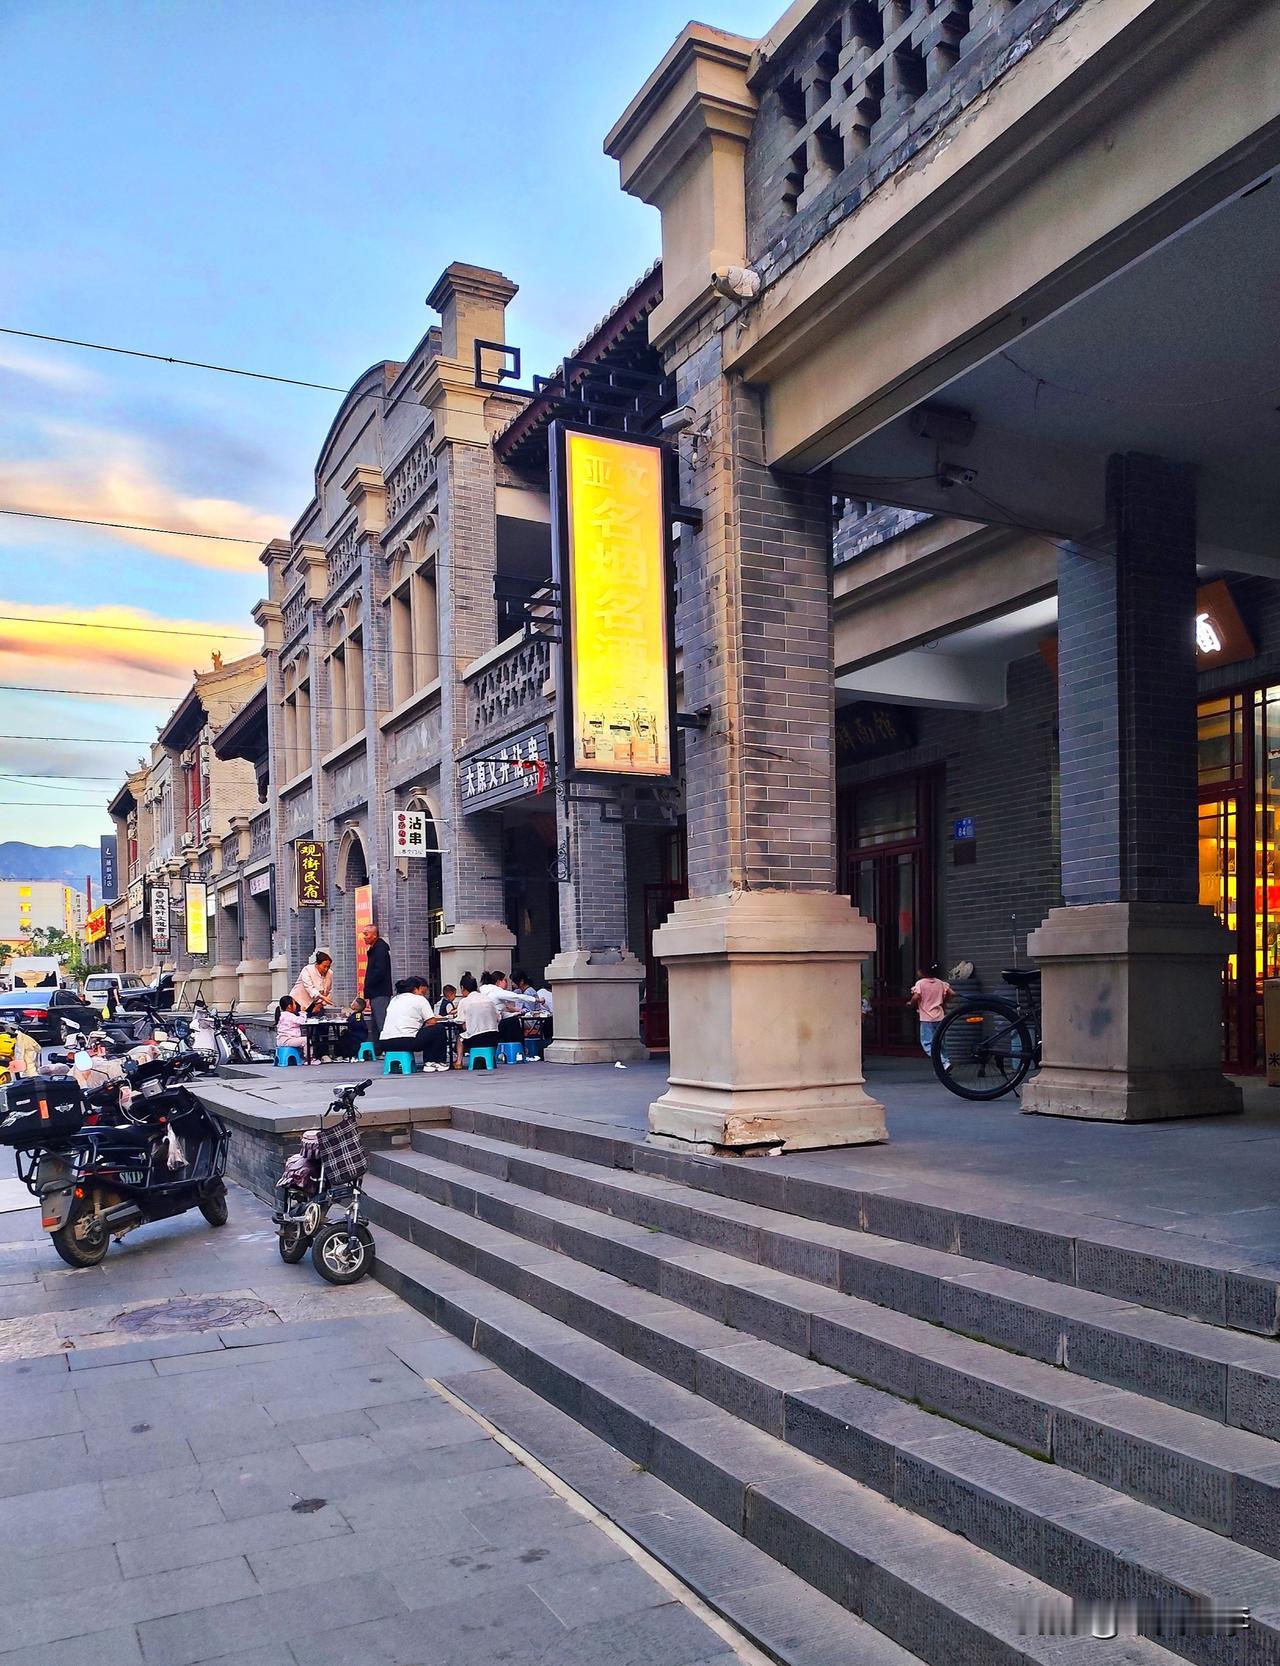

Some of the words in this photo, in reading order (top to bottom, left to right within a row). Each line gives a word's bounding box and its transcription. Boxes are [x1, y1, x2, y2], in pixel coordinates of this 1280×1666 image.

[409, 816, 422, 846] 沾串
[300, 845, 321, 899] 观街民宿
